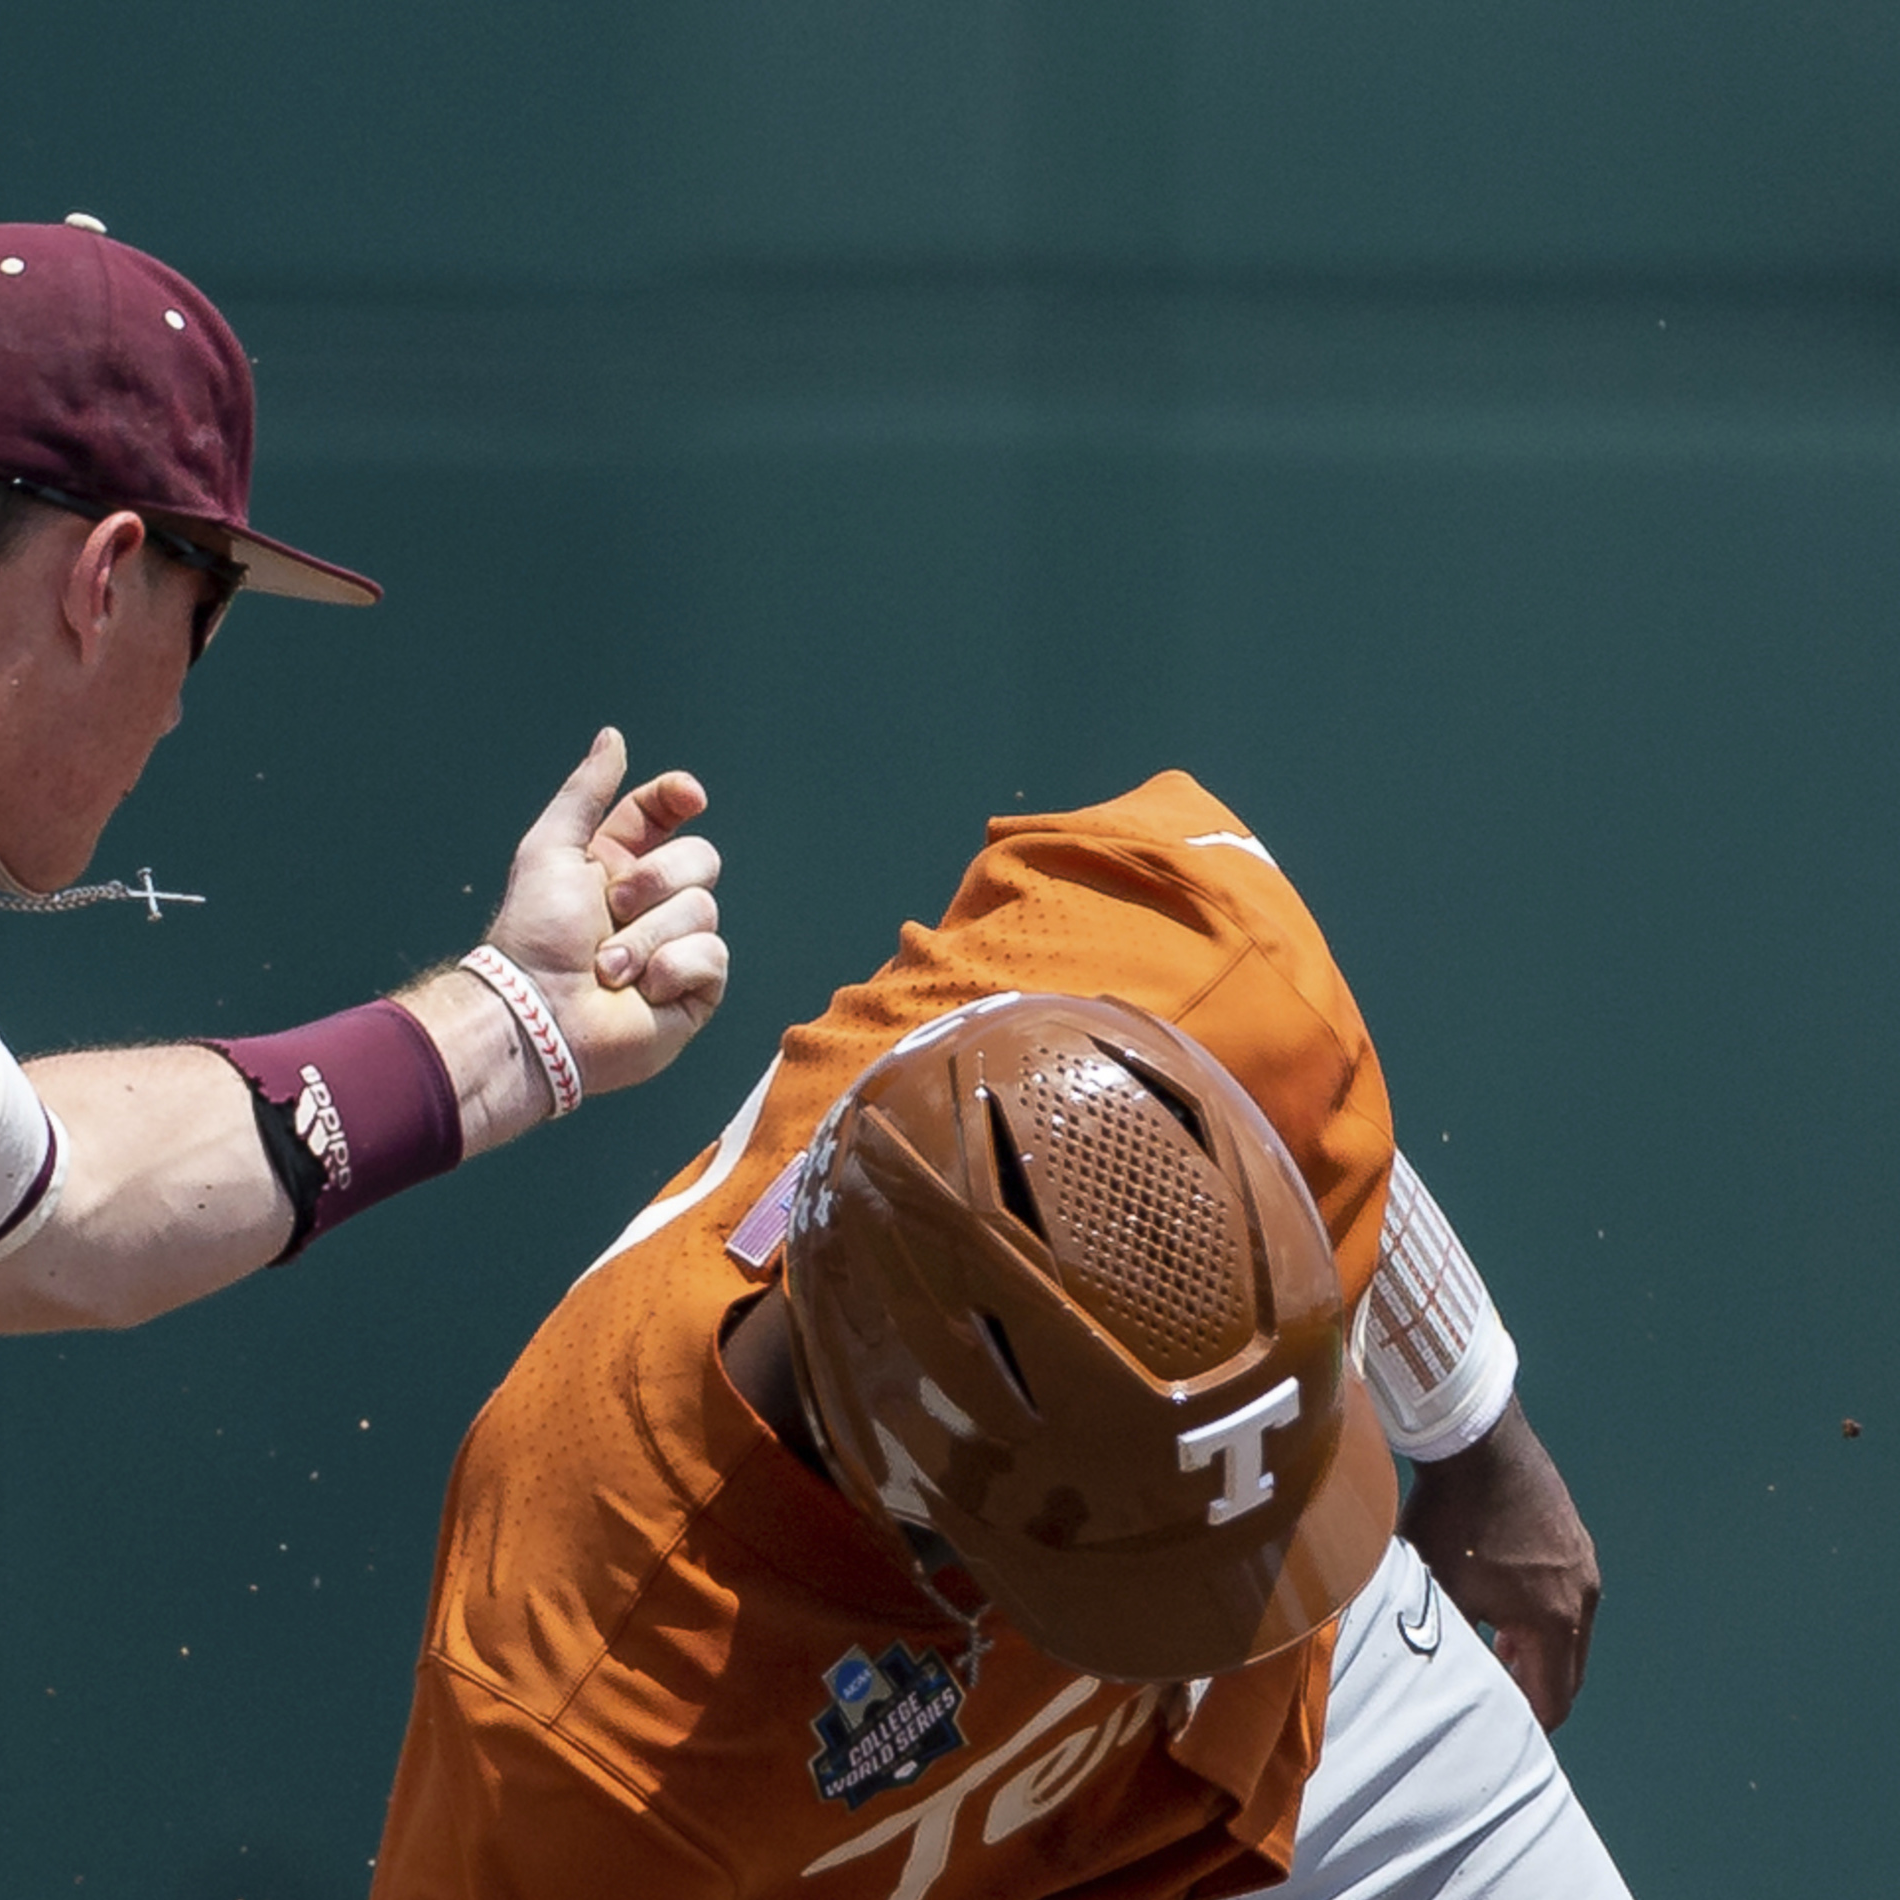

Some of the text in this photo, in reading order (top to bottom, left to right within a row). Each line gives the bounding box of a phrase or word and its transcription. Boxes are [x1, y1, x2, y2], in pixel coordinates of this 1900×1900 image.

[1177, 1374, 1300, 1526] T
[824, 1745, 895, 1797] WORLD
[895, 1686, 956, 1752] SERIES
[849, 1691, 922, 1767] COLLEGE
